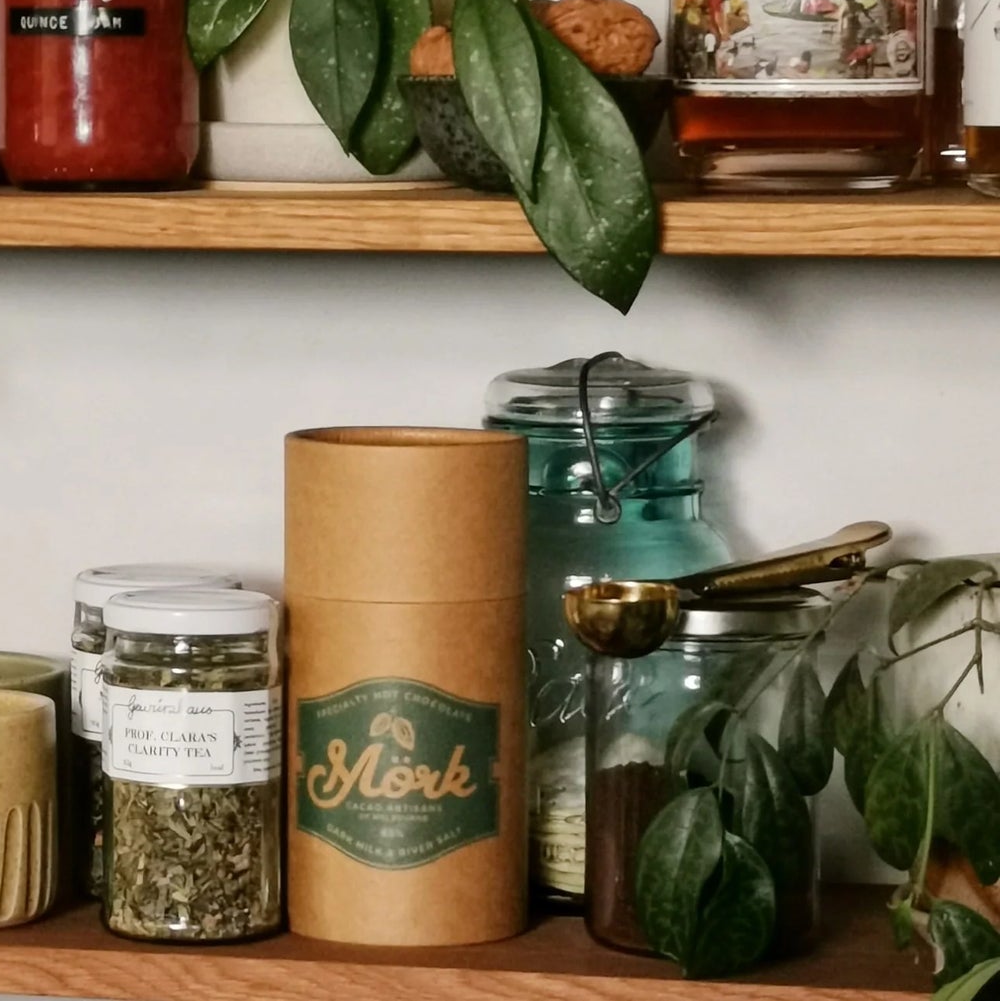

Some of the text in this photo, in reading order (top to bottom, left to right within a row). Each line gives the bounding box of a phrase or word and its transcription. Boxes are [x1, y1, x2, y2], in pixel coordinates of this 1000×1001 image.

[20, 15, 68, 30] QUINCE
[373, 690, 399, 700] HOT
[124, 727, 218, 743] PROF. CLARA'S
[127, 743, 212, 758] CLARITY TEA
[307, 738, 478, 809] Mörk
